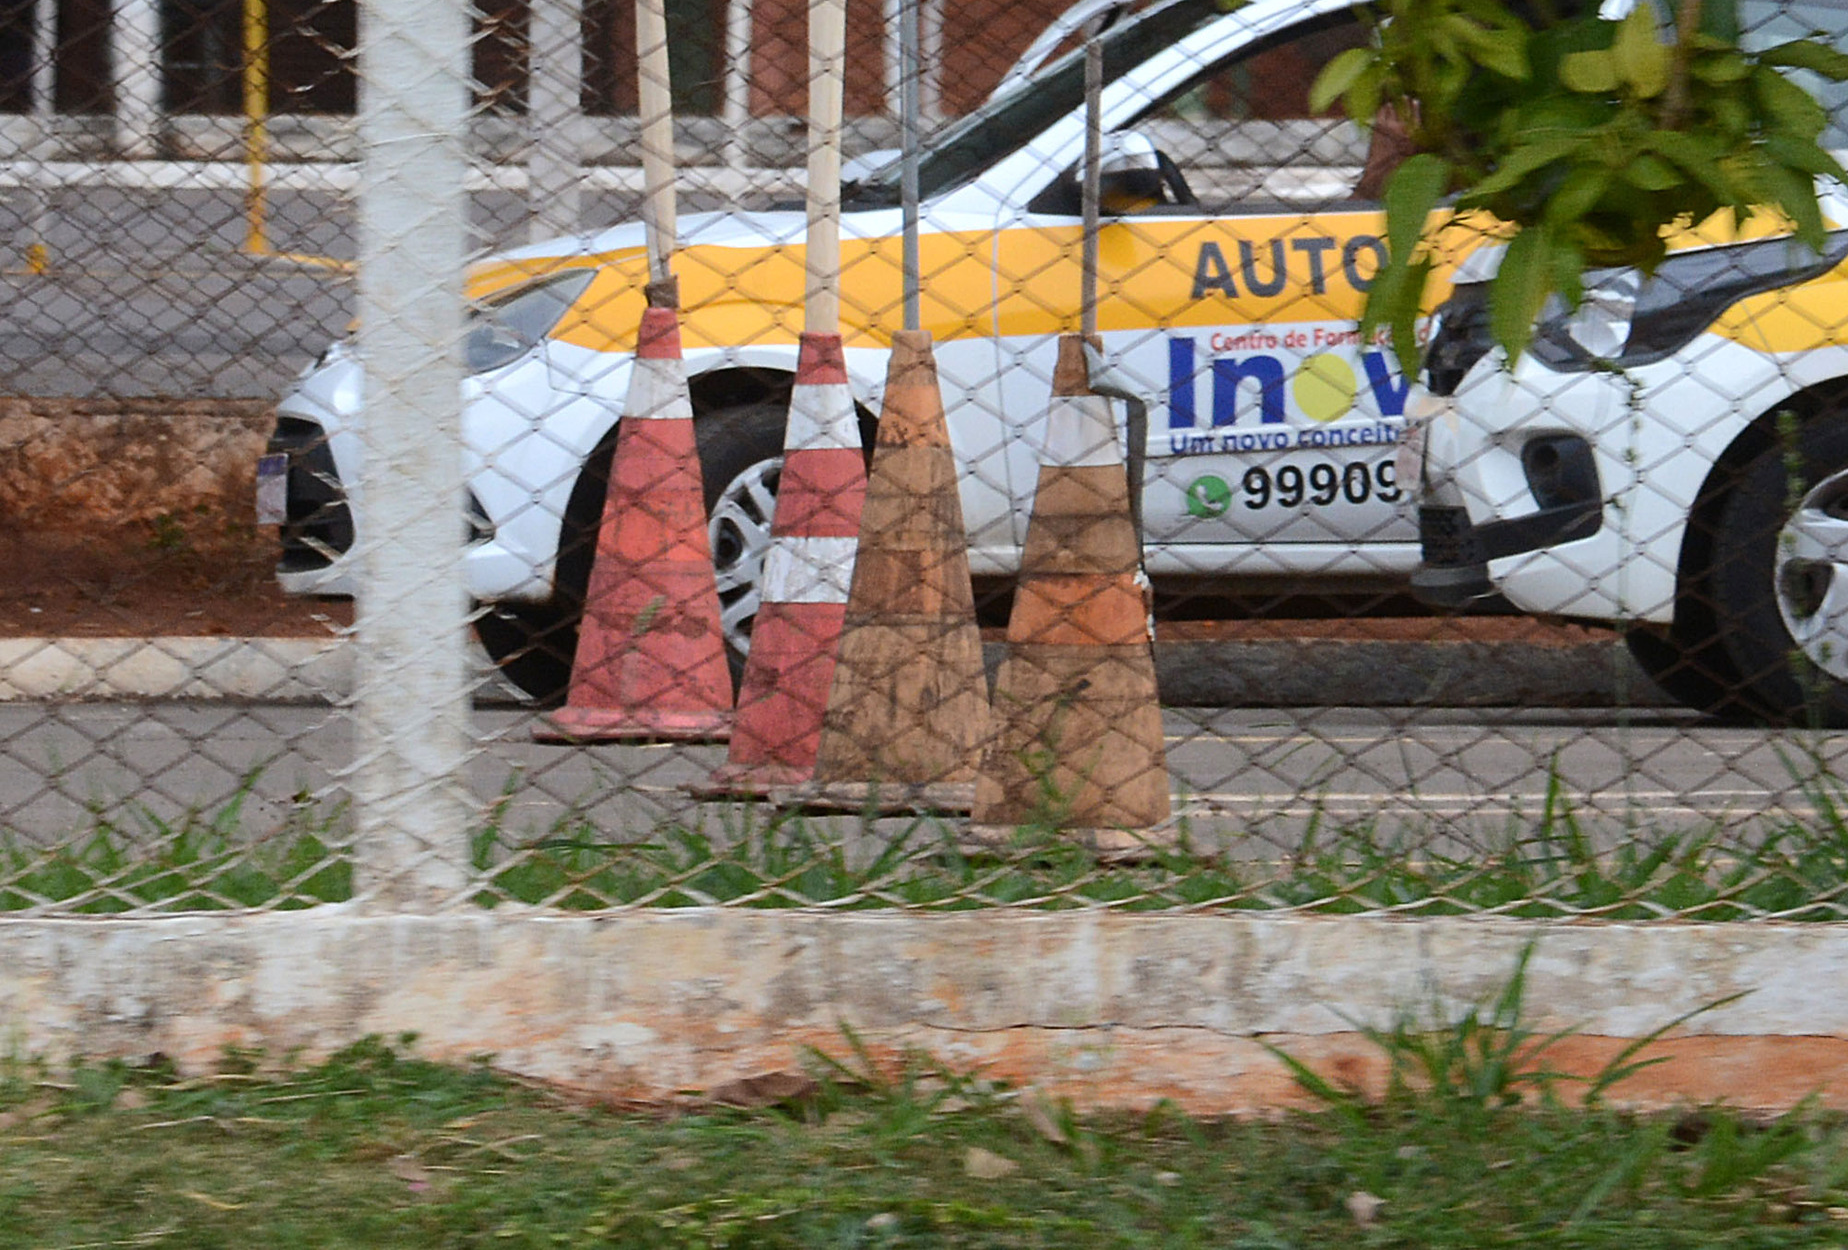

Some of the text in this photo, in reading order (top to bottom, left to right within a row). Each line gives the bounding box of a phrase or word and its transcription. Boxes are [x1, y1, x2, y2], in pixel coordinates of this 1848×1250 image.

[1190, 234, 1388, 300] AUTO
[1211, 332, 1277, 351] Centro
[1285, 330, 1307, 349] de
[1170, 434, 1213, 454] Um
[1222, 431, 1289, 450] novo
[1242, 459, 1402, 509] 99909
